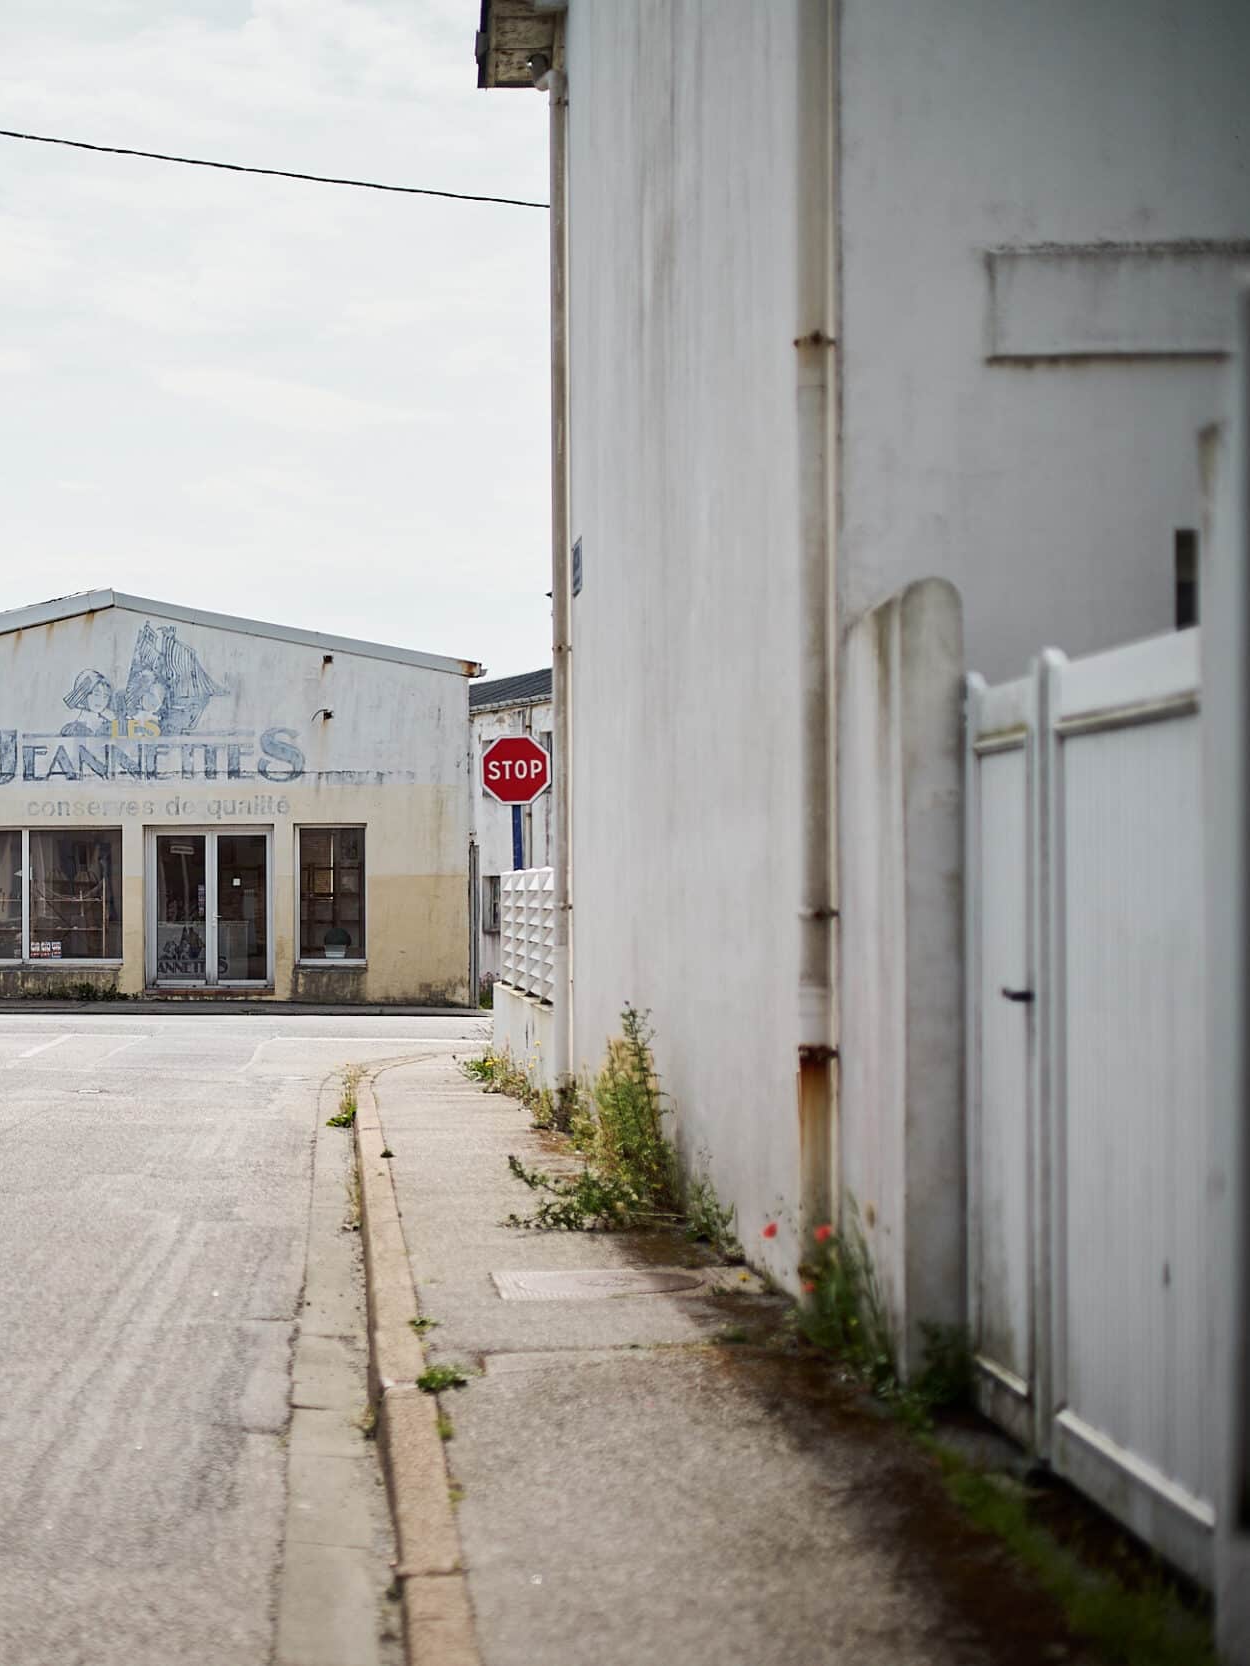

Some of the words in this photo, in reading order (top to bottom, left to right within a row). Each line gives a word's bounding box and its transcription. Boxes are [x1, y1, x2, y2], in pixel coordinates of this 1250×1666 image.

[111, 719, 162, 739] LES
[488, 759, 543, 780] STOP
[165, 796, 195, 817] de
